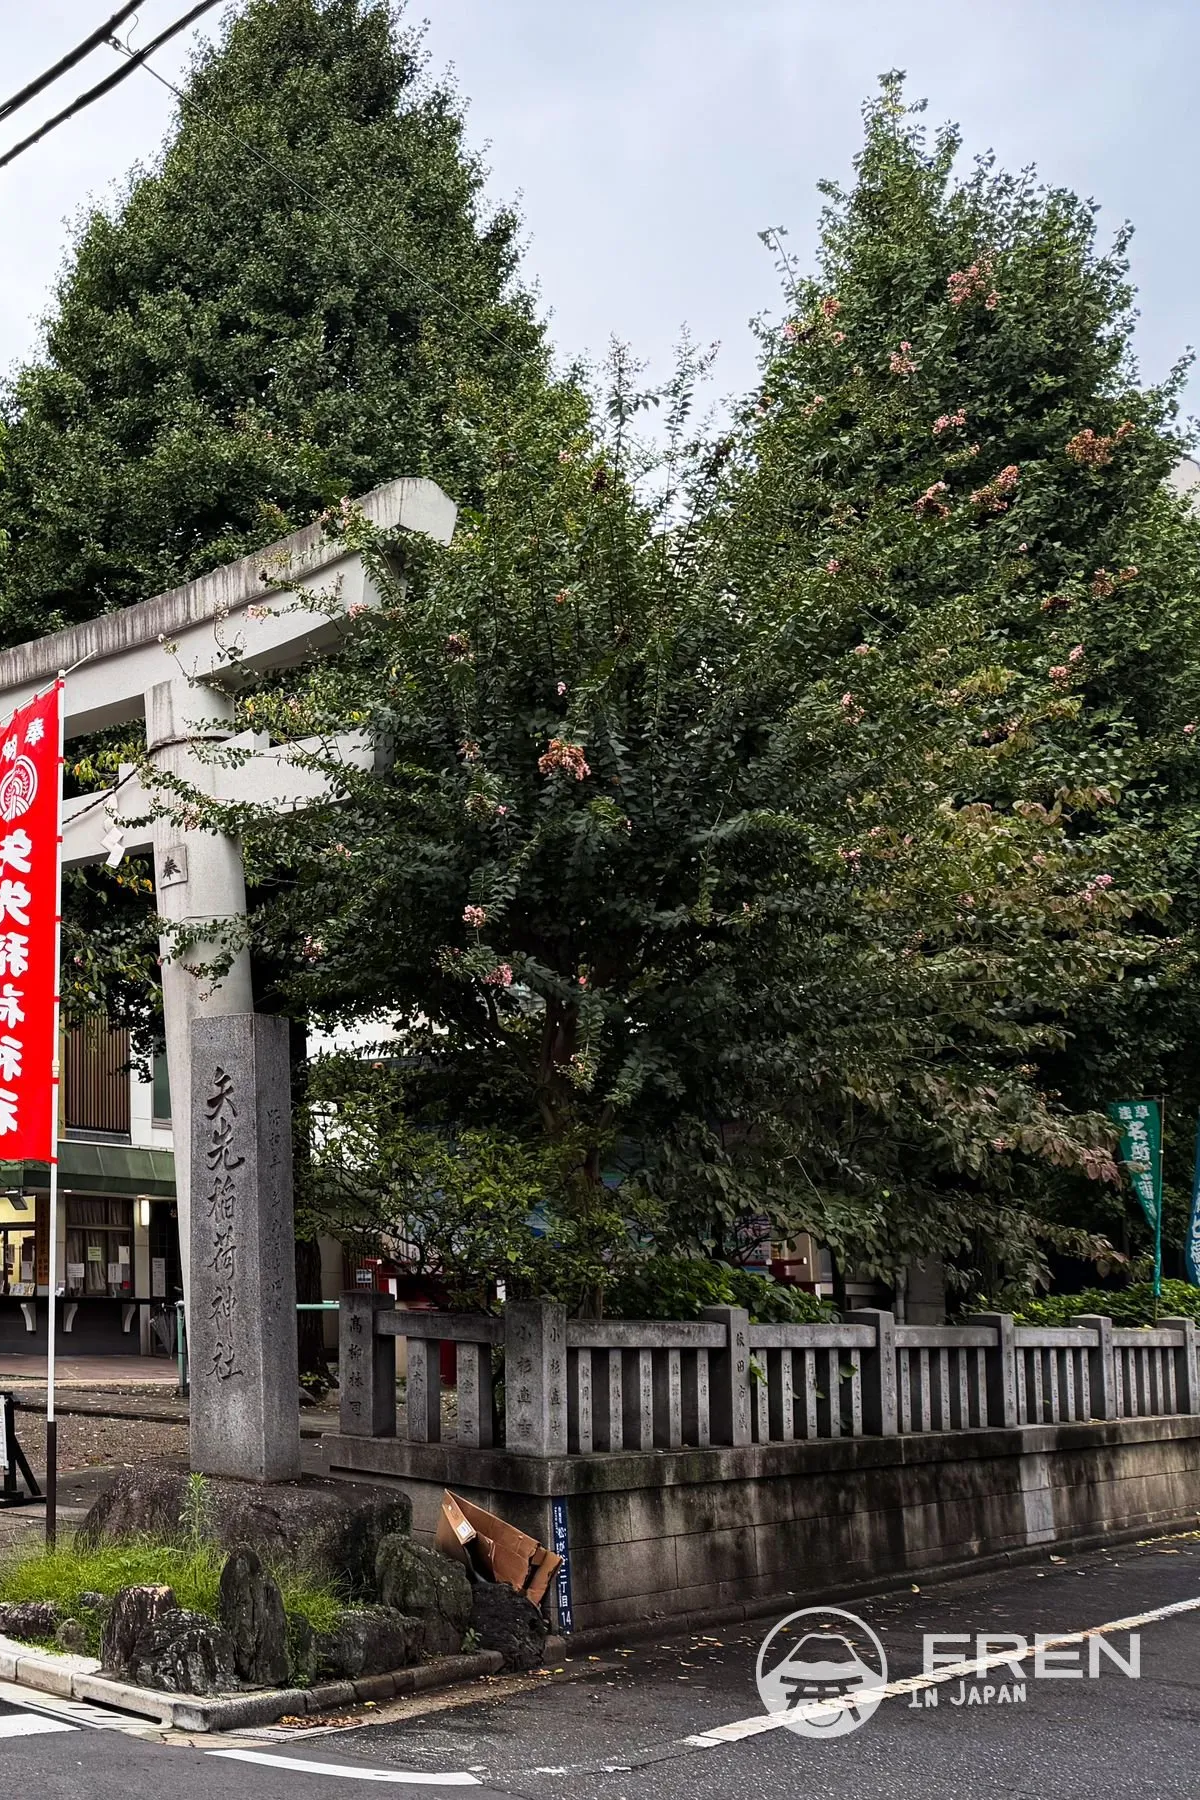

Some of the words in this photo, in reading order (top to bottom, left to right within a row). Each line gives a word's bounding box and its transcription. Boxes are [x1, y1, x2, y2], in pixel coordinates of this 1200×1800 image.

[205, 1066, 245, 1384] 矢先稲荷神社
